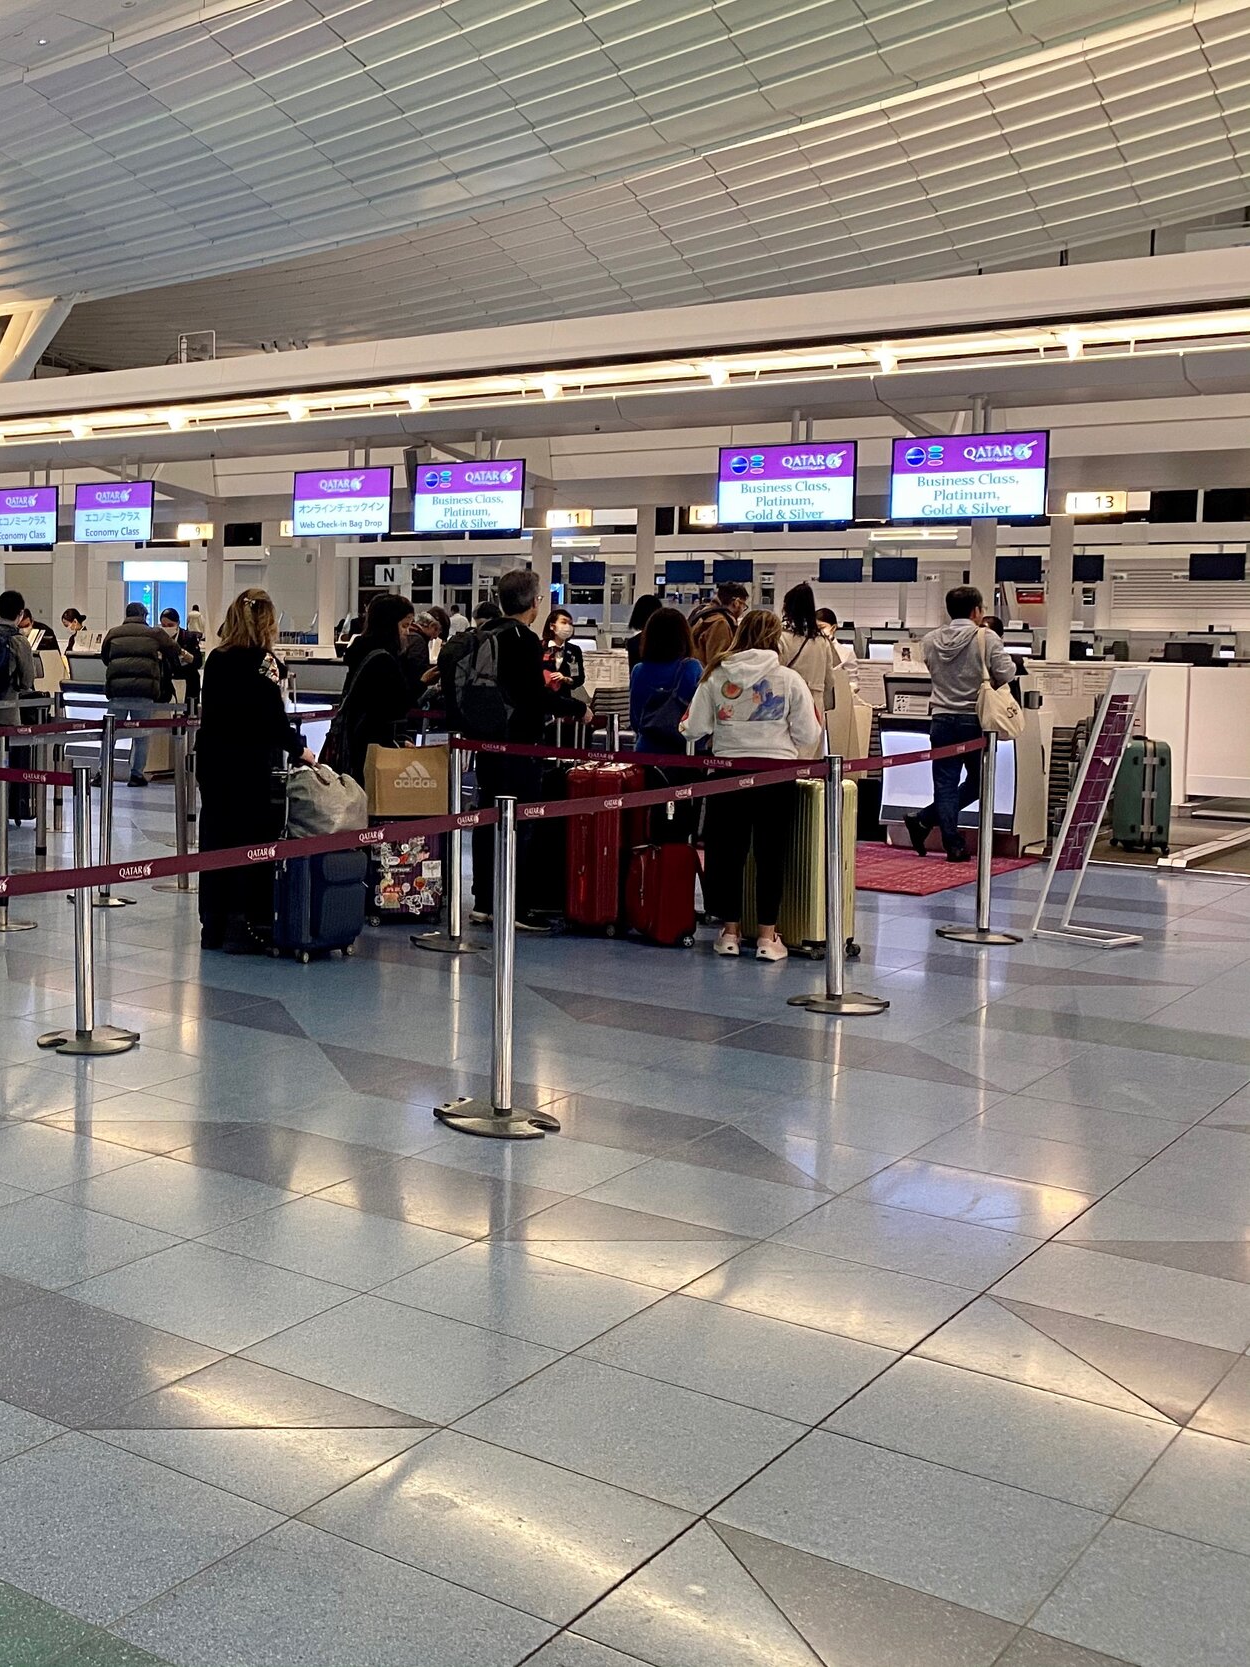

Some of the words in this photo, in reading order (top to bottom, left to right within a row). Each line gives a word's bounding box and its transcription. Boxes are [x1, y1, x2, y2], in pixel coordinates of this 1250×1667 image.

[963, 445, 1013, 461] QATAR
[782, 455, 825, 469] QATAR
[465, 470, 500, 484] QATAR
[917, 475, 975, 487] Business
[978, 473, 1019, 486] Class,
[319, 478, 350, 491] QATAR
[741, 482, 792, 494] Business
[795, 481, 831, 492] Class,
[6, 495, 29, 506] QATAR
[96, 491, 121, 502] QATAR
[432, 495, 473, 506] Business
[475, 494, 504, 505] Class,
[756, 494, 815, 507] Platinum,
[933, 489, 1000, 502] Platinum,
[299, 502, 385, 514] オンラインチェックイン
[444, 507, 491, 518] Platinum,
[922, 504, 953, 516] Gold
[957, 504, 969, 515] &
[972, 503, 1011, 515] Silver
[85, 512, 141, 523] エコノミークラス
[745, 508, 773, 521] Gold
[776, 509, 787, 520] &
[789, 508, 824, 520] Silver
[299, 520, 315, 529] Web
[316, 519, 348, 528] Check-in
[349, 520, 363, 530] Bag
[365, 519, 383, 529] Drop
[435, 518, 458, 529] Gold
[460, 519, 468, 528] &
[470, 518, 498, 528] Silver
[29, 530, 46, 539] Class
[85, 527, 119, 537] Economy
[121, 526, 140, 536] Class
[383, 567, 395, 583] N
[394, 777, 437, 788] adidas
[359, 831, 377, 842] QATAR
[248, 847, 268, 859] QATAR
[119, 865, 143, 878] QATAR
